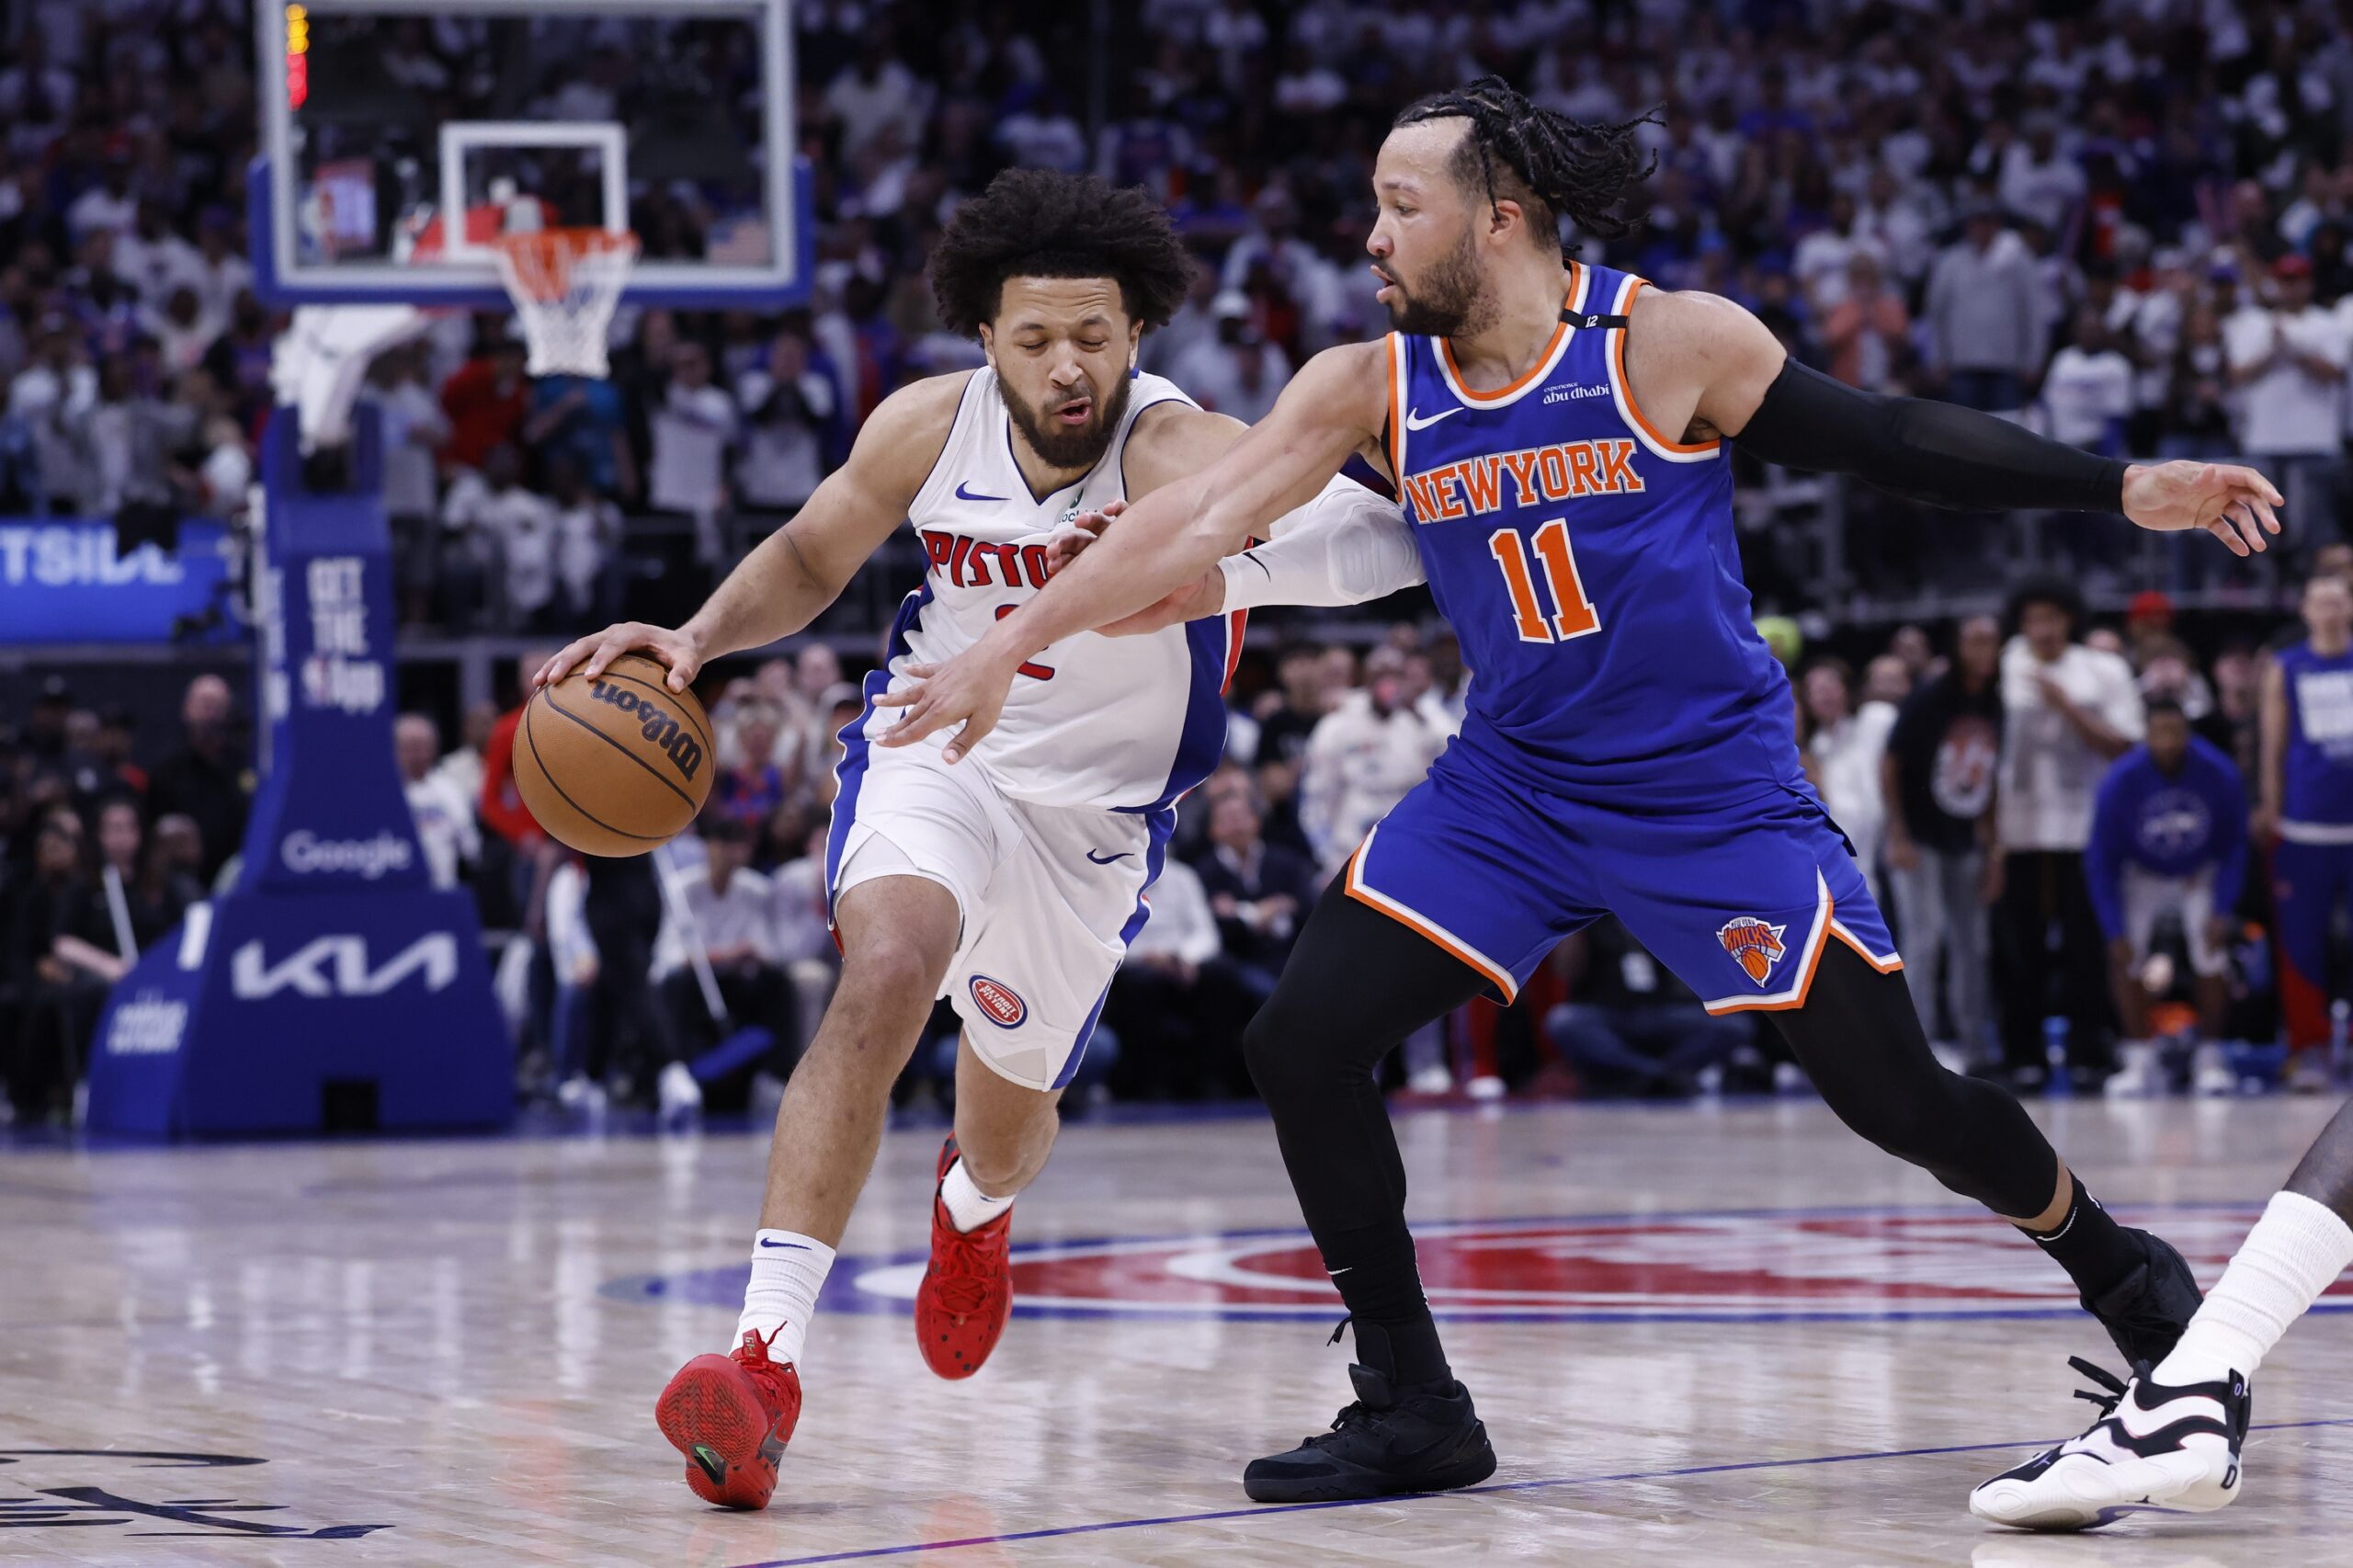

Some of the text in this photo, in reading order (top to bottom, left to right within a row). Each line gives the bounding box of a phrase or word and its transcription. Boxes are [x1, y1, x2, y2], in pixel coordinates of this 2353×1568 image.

[1585, 314, 1599, 328] 12
[1542, 383, 1610, 405] abu dhabi
[1543, 382, 1579, 393] experience
[920, 528, 1056, 590] PISTO
[1488, 517, 1602, 644] 11
[590, 679, 703, 782] Wilson
[279, 828, 413, 881] Google
[1723, 923, 1782, 953] KNICKS
[232, 931, 459, 999] KIA
[978, 986, 1012, 1018] PISTONS
[983, 983, 1017, 1015] DETROIT
